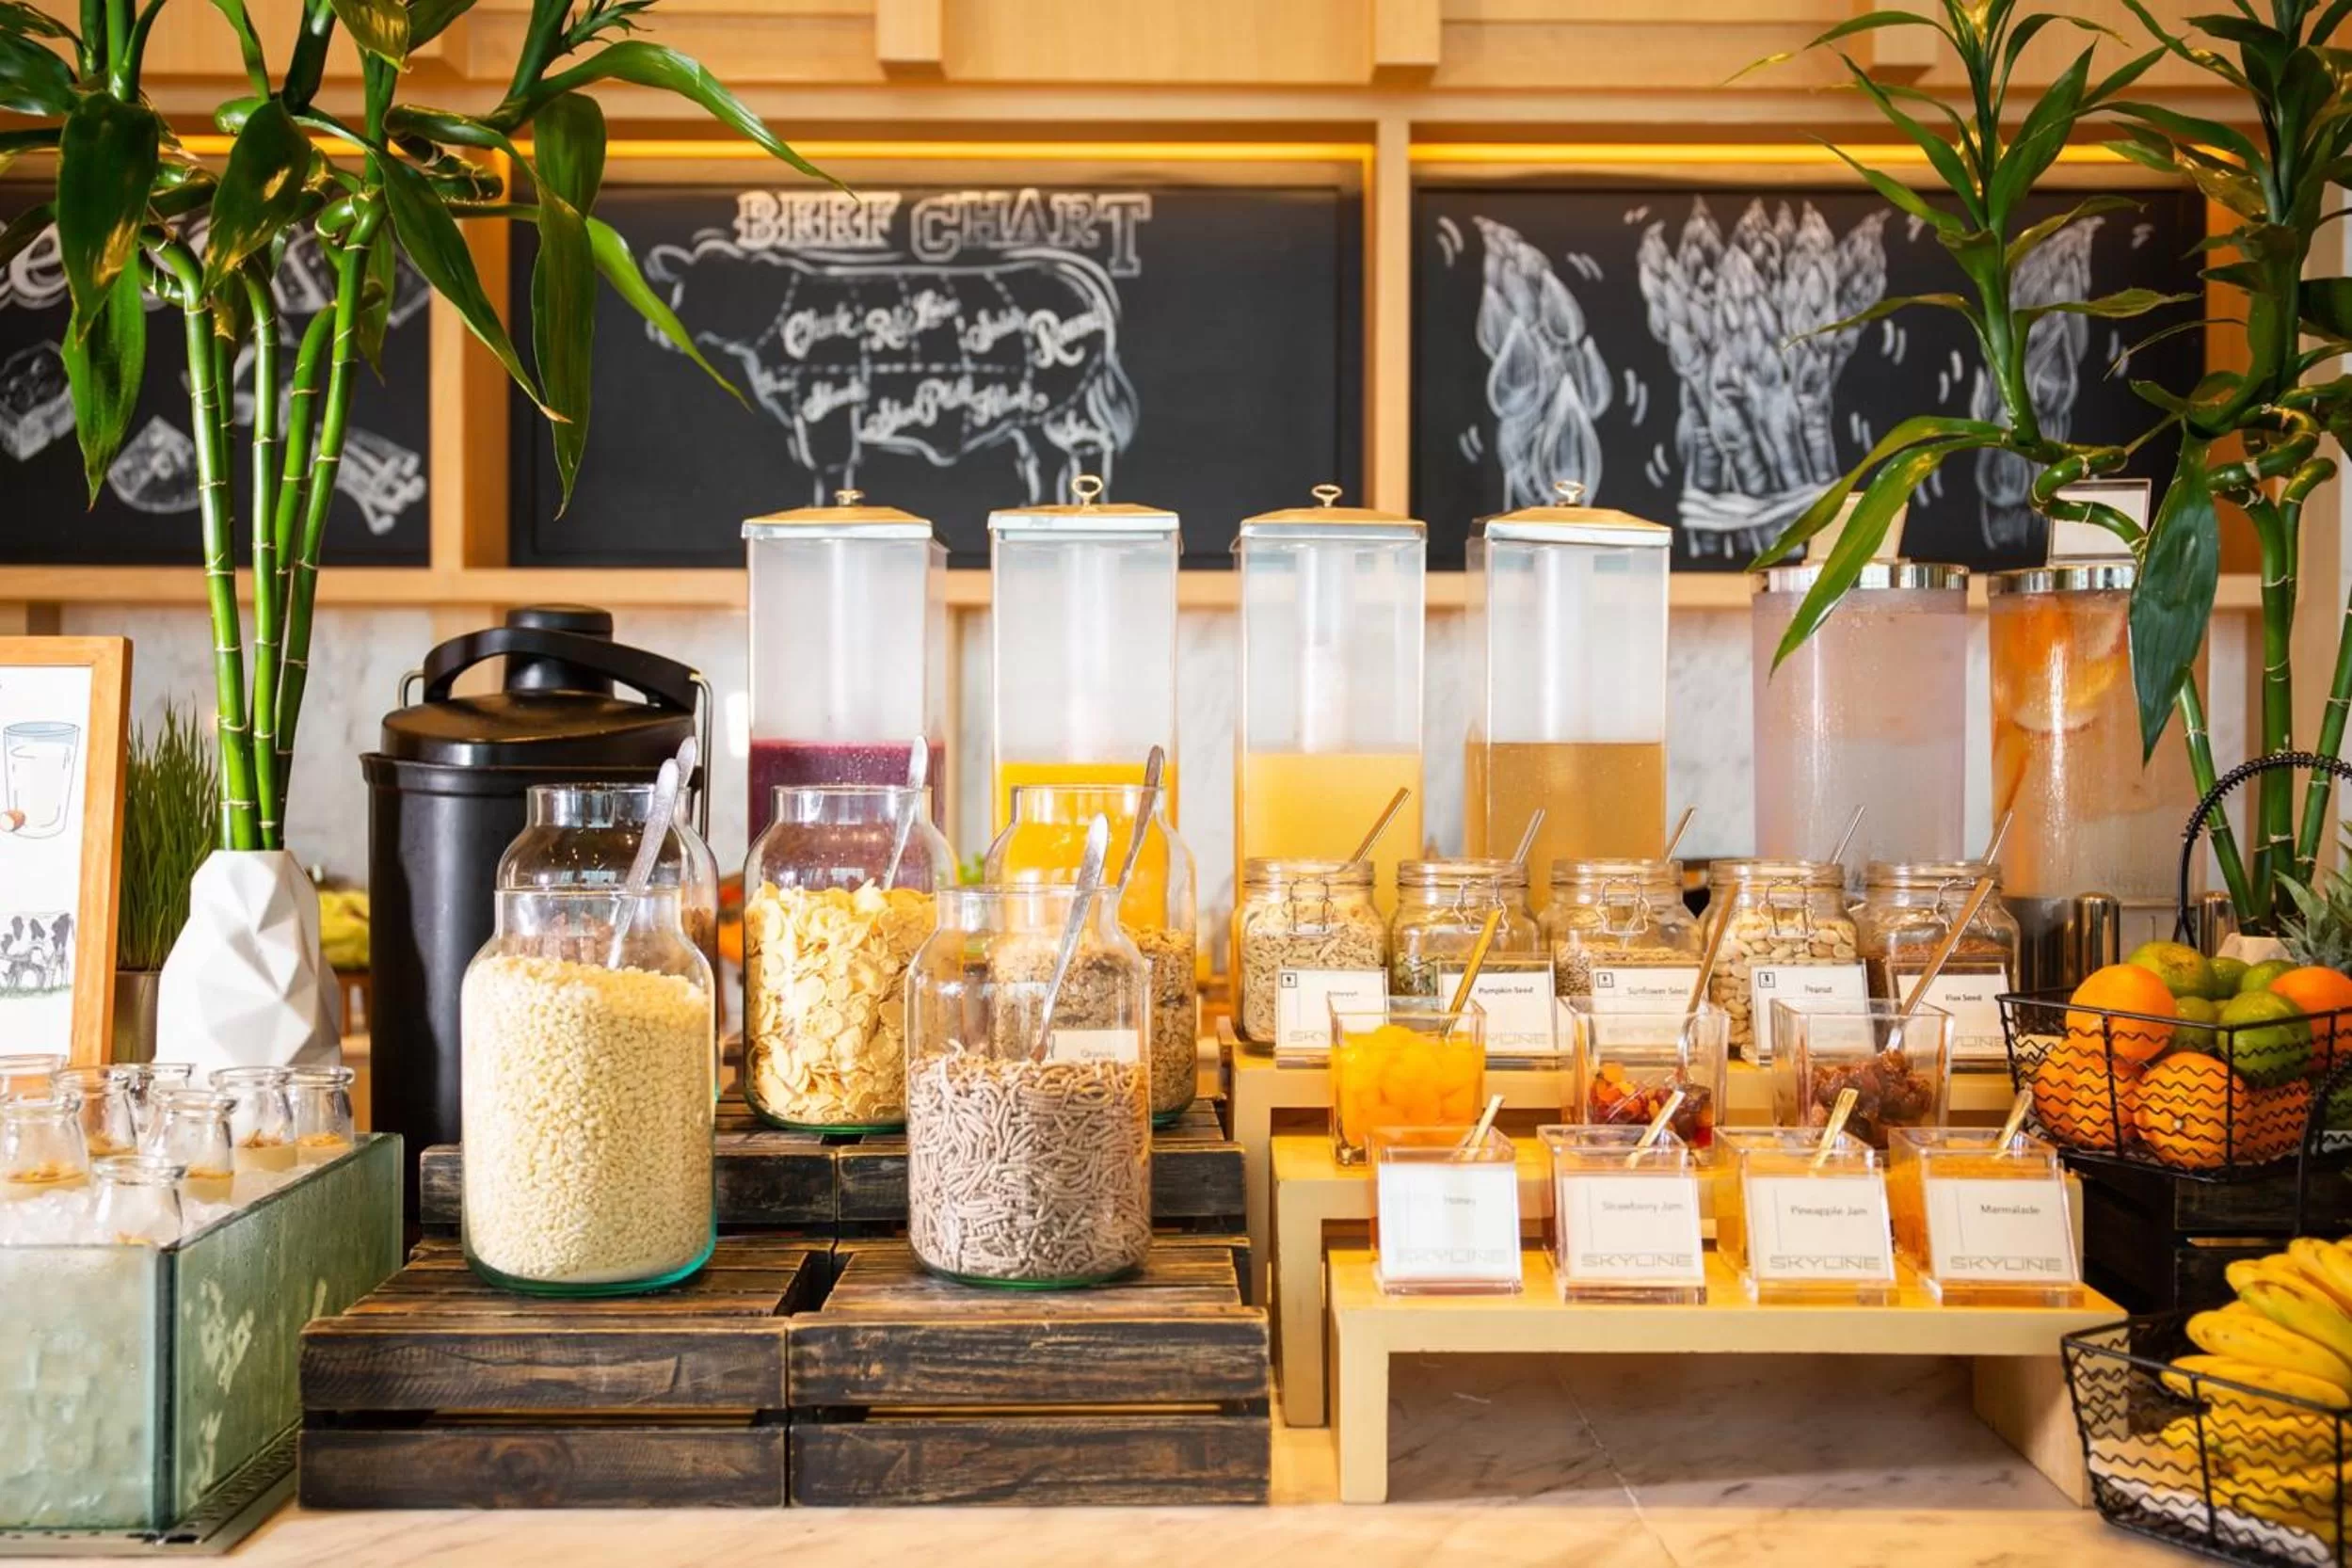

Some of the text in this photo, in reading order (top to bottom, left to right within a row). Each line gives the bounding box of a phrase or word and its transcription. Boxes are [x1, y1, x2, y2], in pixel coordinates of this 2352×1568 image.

[733, 188, 1152, 277] BEEF CHART
[1513, 985, 1534, 994] Seed
[1790, 1204, 1867, 1216] Pineapple Jam
[1980, 1204, 2041, 1215] Marmalade
[1580, 1252, 1692, 1268] SKYLINE
[1768, 1255, 1880, 1270] SKYLINE
[1949, 1256, 2062, 1271] SKYLINE
